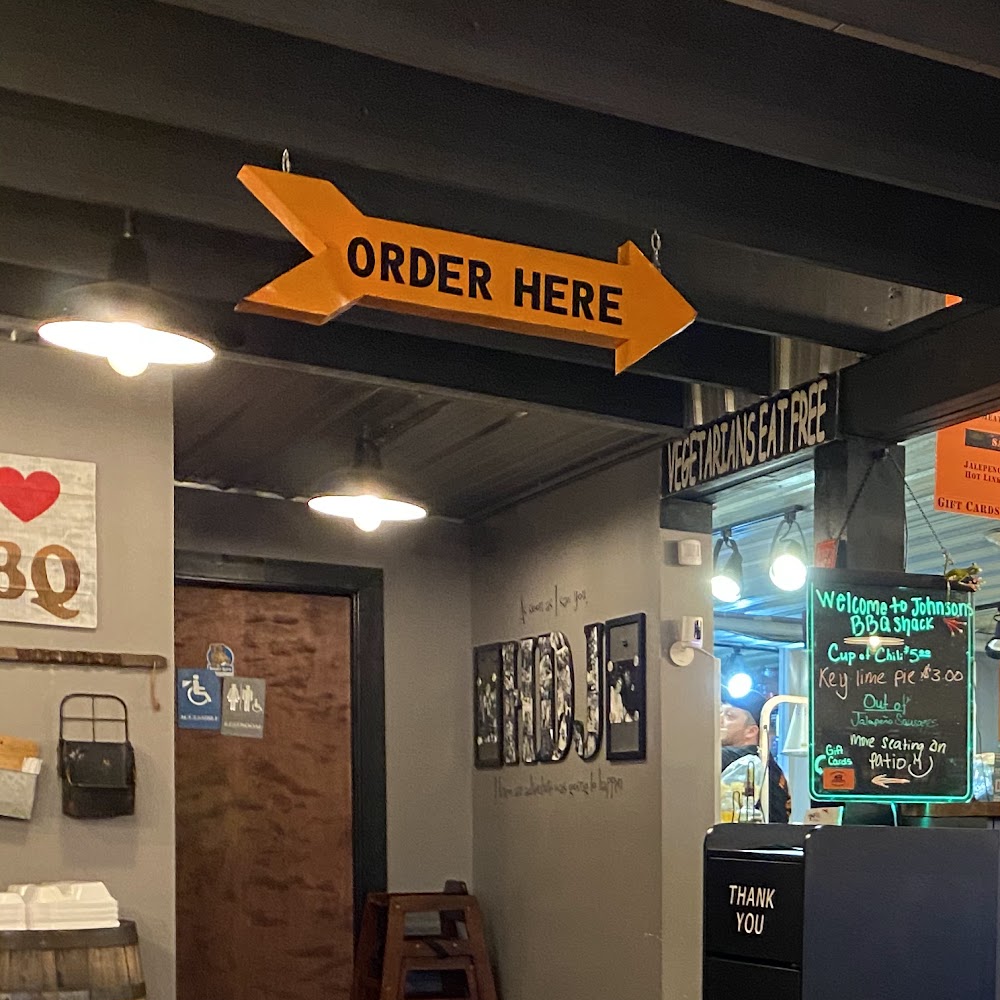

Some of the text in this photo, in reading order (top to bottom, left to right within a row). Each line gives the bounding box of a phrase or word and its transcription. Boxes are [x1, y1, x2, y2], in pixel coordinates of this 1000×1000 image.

[347, 236, 624, 326] ORDER HERE
[667, 378, 829, 493] VEGETARIANS EAT FREE
[965, 471, 982, 481] HOT
[937, 496, 963, 511] GIFT
[966, 501, 1000, 516] CARDS
[816, 588, 973, 617] Welcome to Johnsons
[850, 614, 892, 637] BBQ
[827, 642, 904, 666] Cup of Chili
[818, 667, 848, 700] Key
[856, 670, 887, 686] lime
[863, 693, 888, 710] Out
[728, 884, 776, 935] THANK YOU
